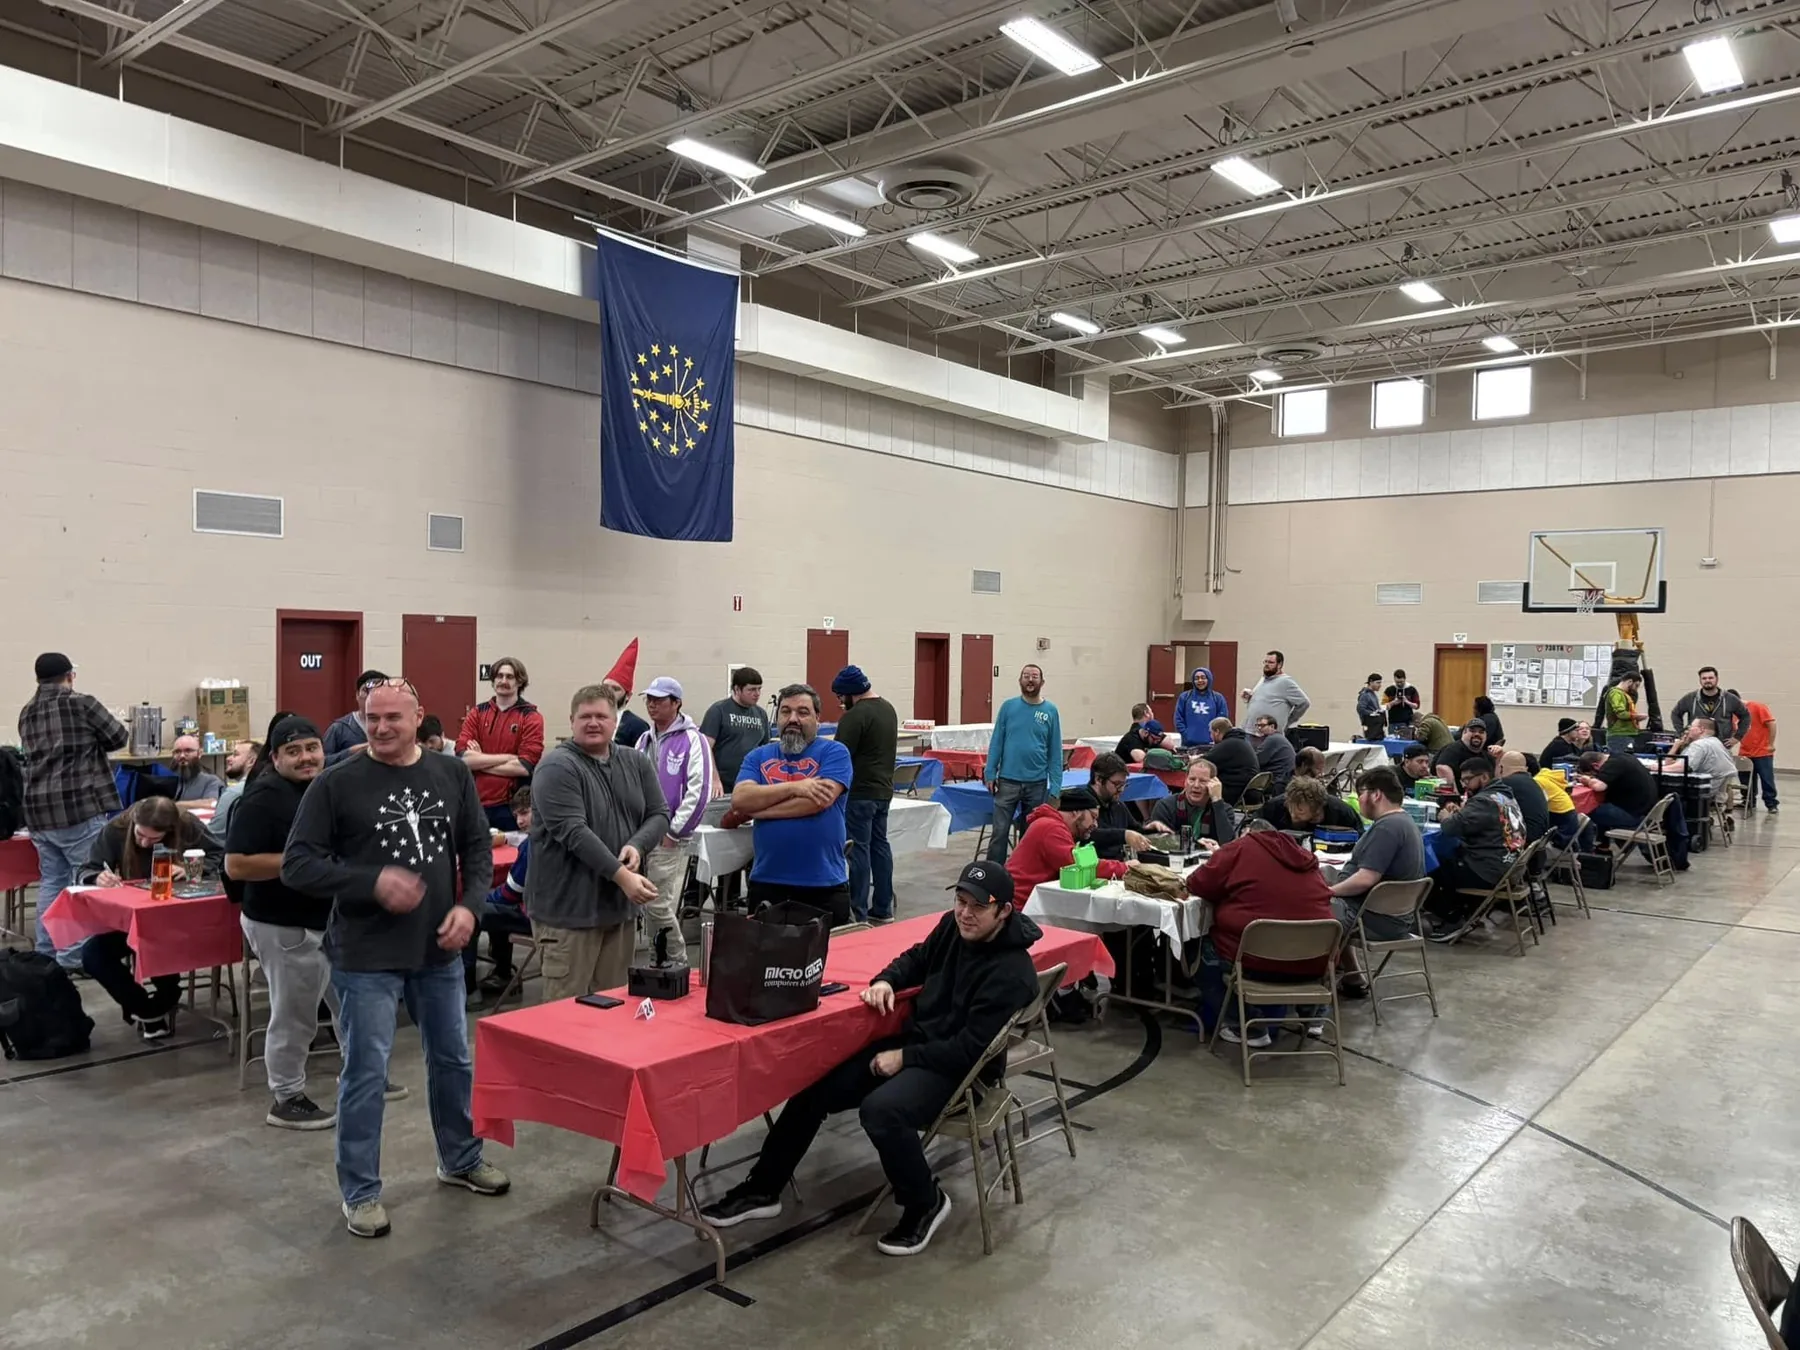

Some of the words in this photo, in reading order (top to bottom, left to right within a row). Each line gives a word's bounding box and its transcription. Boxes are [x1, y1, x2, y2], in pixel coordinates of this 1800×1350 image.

[300, 654, 322, 668] OUT
[729, 713, 762, 726] PURDUE
[764, 966, 803, 980] MICRO
[763, 979, 799, 988] computers
[643, 1001, 654, 1017] 24
